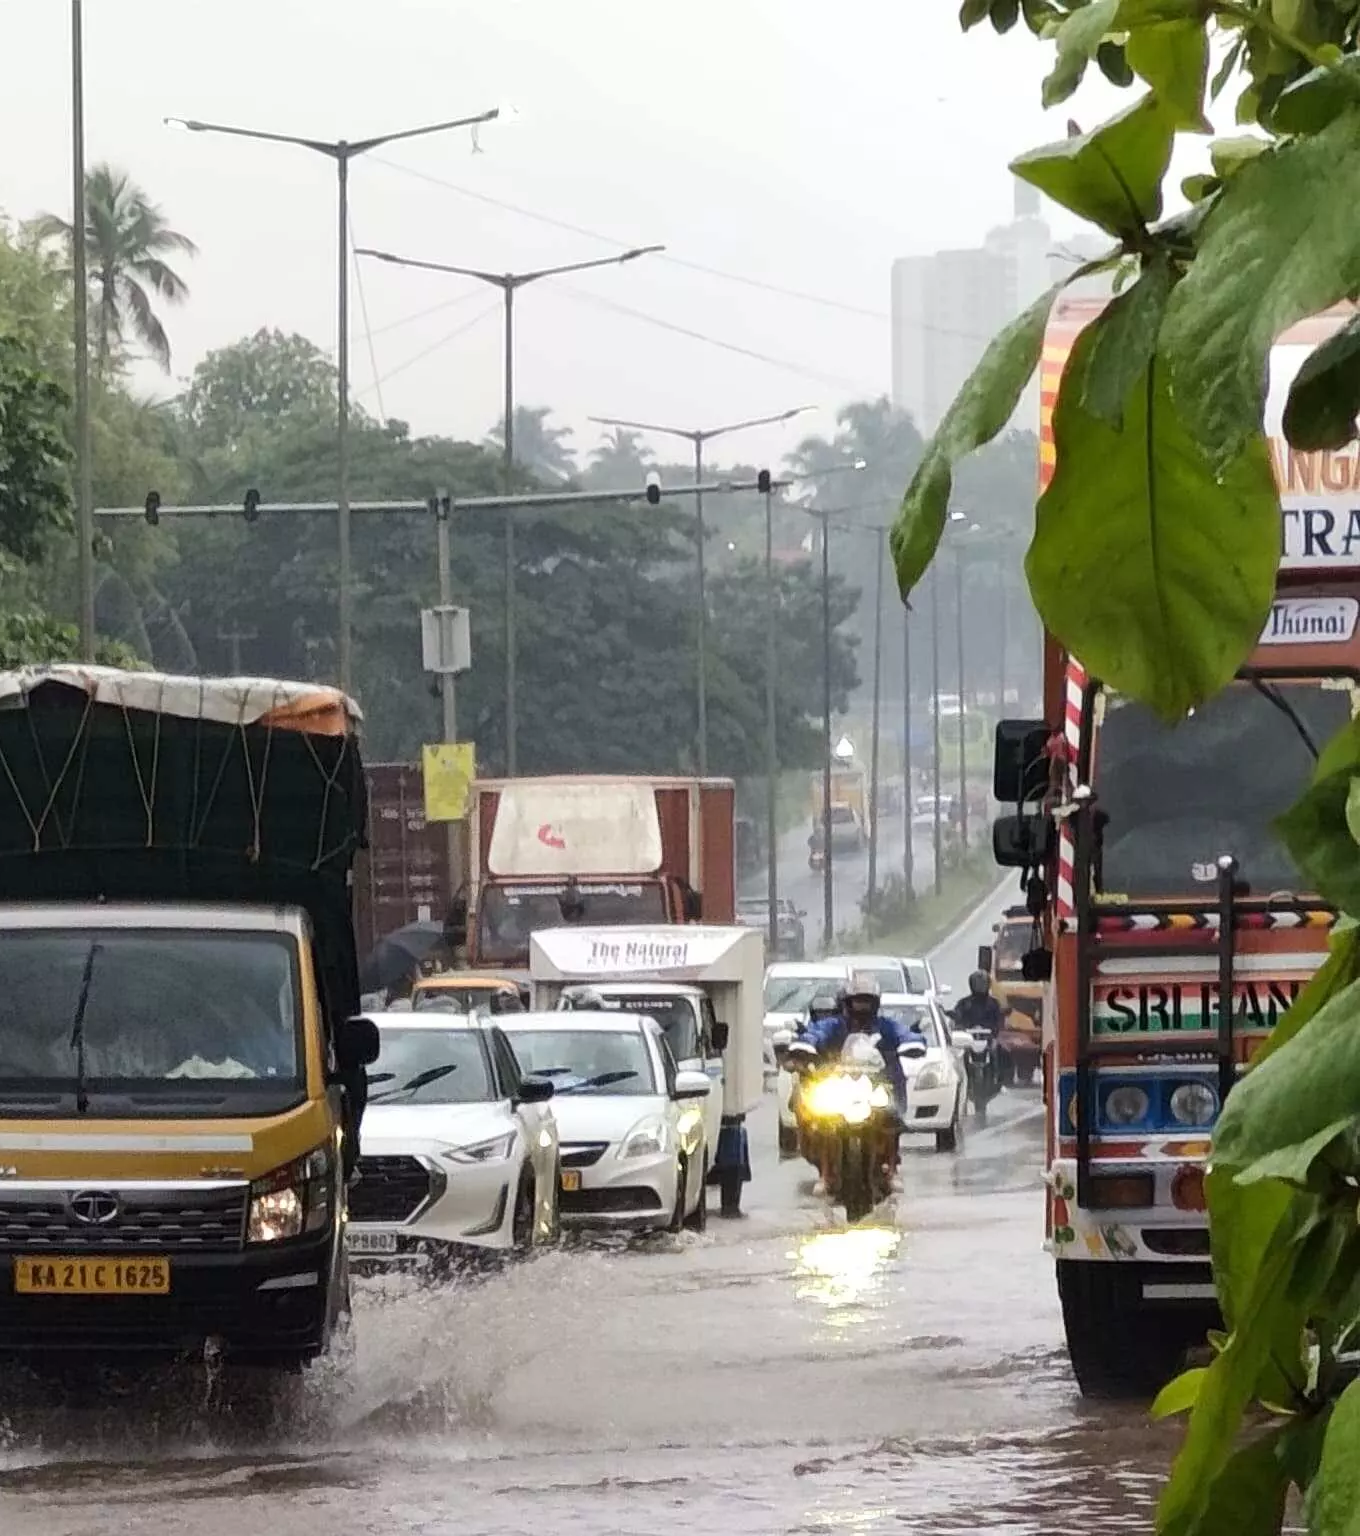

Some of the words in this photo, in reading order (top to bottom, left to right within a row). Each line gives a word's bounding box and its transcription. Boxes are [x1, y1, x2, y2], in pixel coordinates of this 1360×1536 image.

[1267, 437, 1360, 492] NG
[625, 941, 689, 958] Natural
[1106, 982, 1183, 1032] SRI
[31, 1264, 56, 1288] KA
[63, 1264, 87, 1288] 21
[94, 1265, 106, 1288] C
[114, 1264, 165, 1288] 1625
